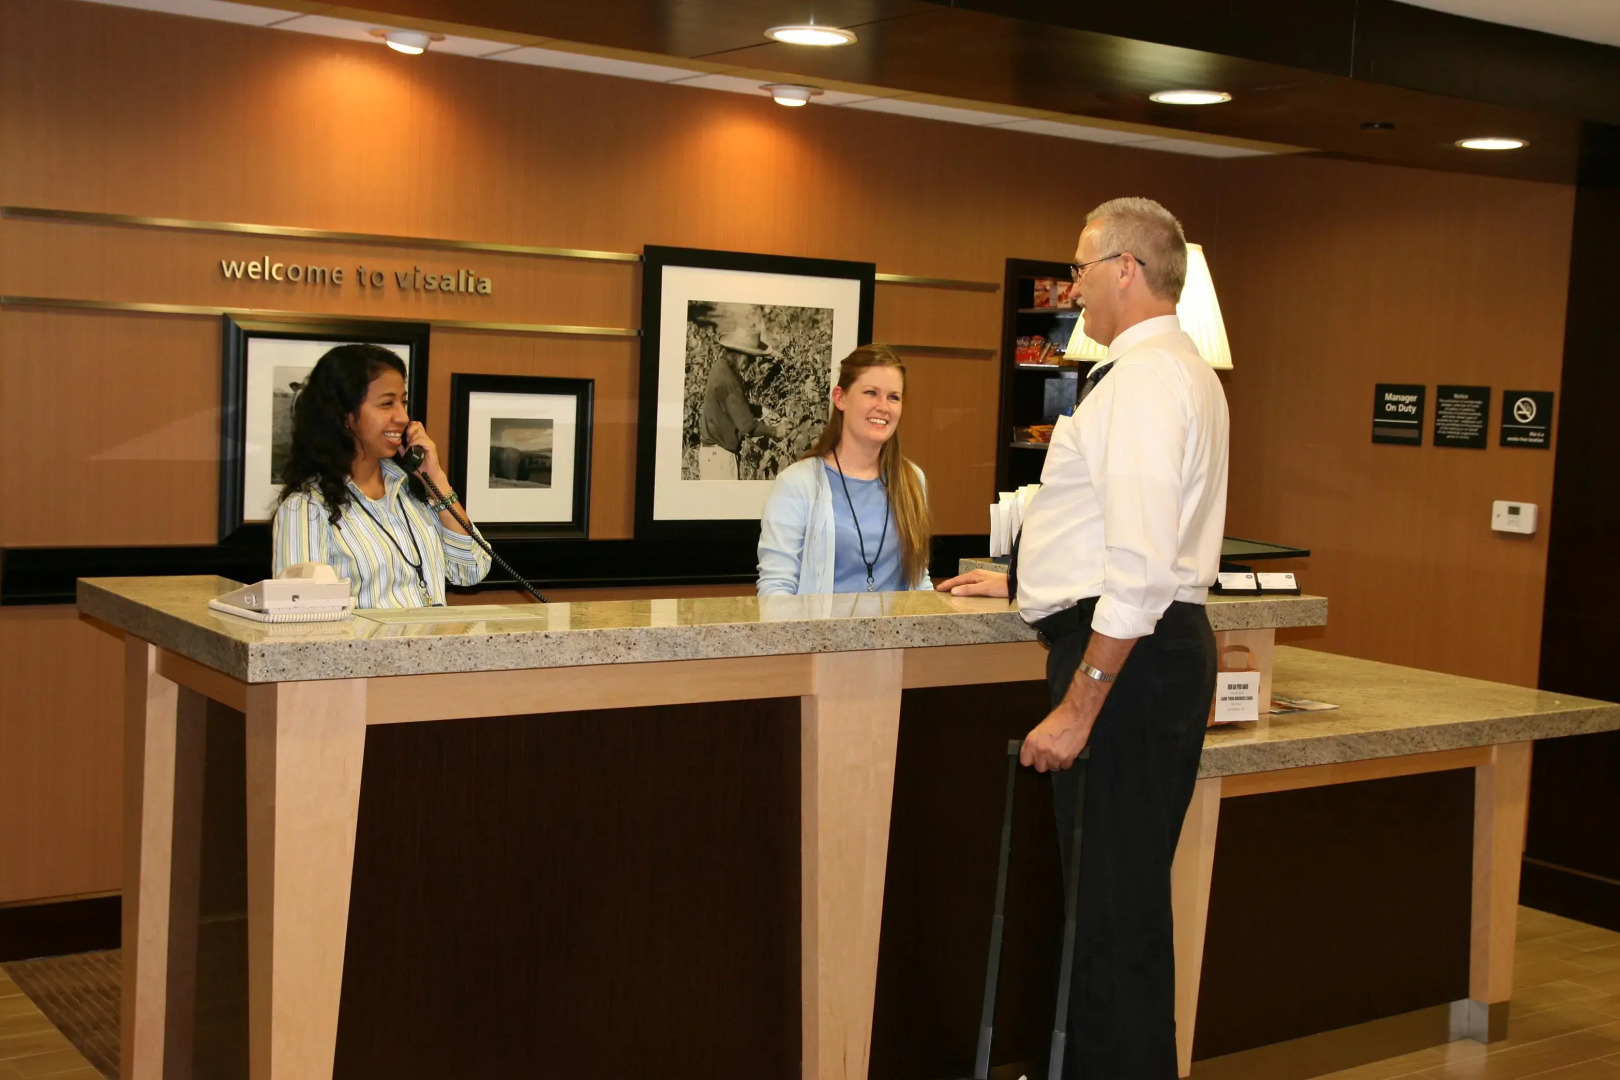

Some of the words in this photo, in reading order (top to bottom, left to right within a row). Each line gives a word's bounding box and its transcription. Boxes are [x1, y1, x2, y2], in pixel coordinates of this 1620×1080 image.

[220, 255, 344, 286] welcome
[356, 265, 384, 288] to
[394, 265, 492, 294] visalia
[1384, 393, 1418, 404] Manager
[1385, 402, 1397, 412] On
[1398, 403, 1417, 415] Duty
